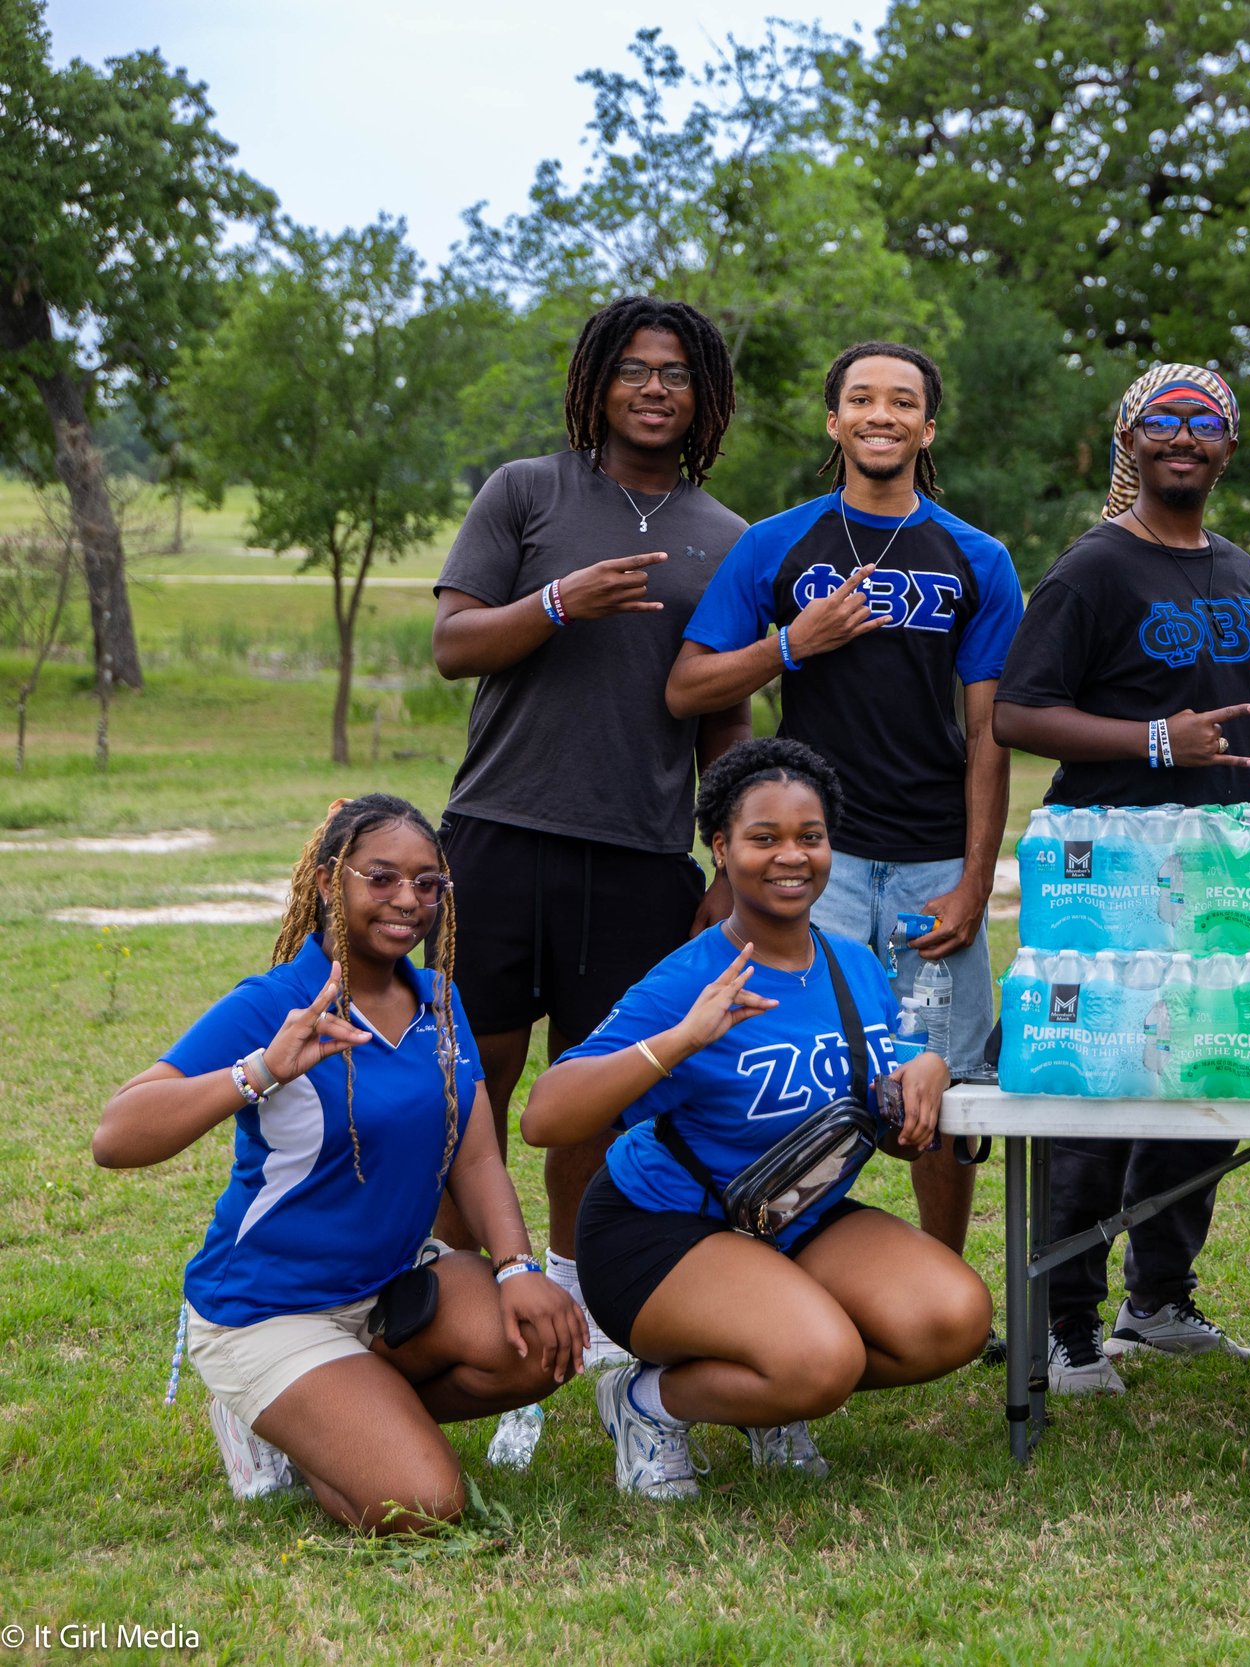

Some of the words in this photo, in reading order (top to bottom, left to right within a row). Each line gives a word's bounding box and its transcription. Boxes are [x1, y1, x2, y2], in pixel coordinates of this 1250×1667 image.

[1036, 850, 1056, 864] 40
[1041, 883, 1107, 898] PURIFIED
[1107, 884, 1160, 899] WATER
[1050, 896, 1073, 909] FOR
[1076, 896, 1105, 911] YOUR
[1108, 898, 1149, 911] THIRST
[1194, 901, 1213, 912] FOR
[1213, 899, 1239, 908] THE
[1020, 989, 1042, 1005] 40
[1023, 1024, 1093, 1044] PURIFIED
[1093, 1031, 1147, 1046] WATER
[1031, 1041, 1056, 1053] FOR
[1060, 1040, 1089, 1057] YOUR
[1091, 1045, 1137, 1057] THIRST
[1181, 1048, 1203, 1060] FOR
[1206, 1047, 1231, 1056] THE
